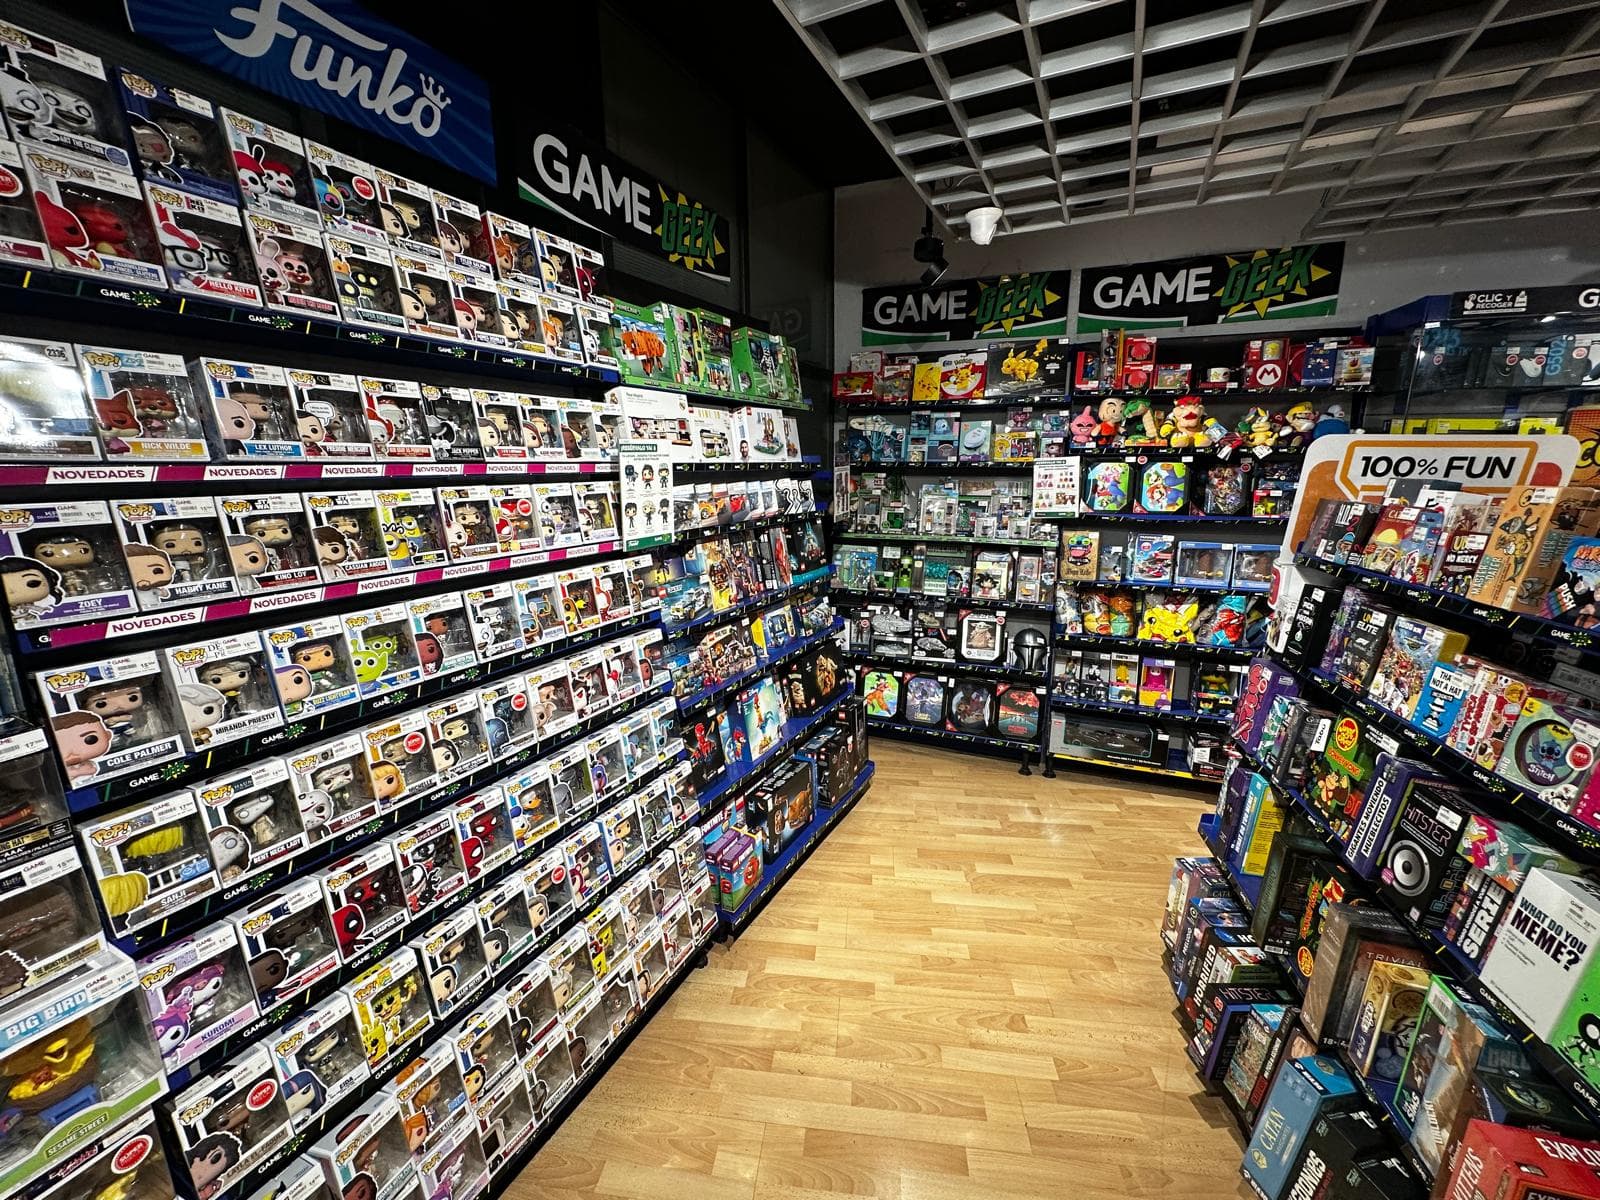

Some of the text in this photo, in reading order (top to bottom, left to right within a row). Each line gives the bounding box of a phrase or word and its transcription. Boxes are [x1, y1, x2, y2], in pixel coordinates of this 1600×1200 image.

[214, 0, 443, 138] Funko
[533, 134, 718, 260] GAME GEEK
[1094, 245, 1318, 309] GAME GEEK
[100, 289, 131, 301] GAME
[209, 279, 256, 296] HELLO KITTY
[874, 272, 1051, 324] GAME GEEK
[1477, 294, 1504, 302] CLIC
[249, 314, 272, 325] GAME
[141, 442, 191, 452] NICK WILDE
[255, 443, 293, 453] LEX LUTHOR
[53, 468, 145, 480] NOVEDADES
[209, 467, 277, 477] NOVEDADES
[325, 466, 378, 475] NOVEDADES
[415, 465, 458, 474] NOVEDADES
[488, 464, 523, 473] NOVEDADES
[1361, 456, 1516, 479] 100% FUN
[512, 553, 545, 565] NOVEDADES
[444, 564, 484, 578] NOVEDADES
[1471, 556, 1489, 596] MASTER
[205, 581, 229, 592] KANE
[361, 576, 410, 591] NOVEDADES
[78, 599, 103, 609] ZOEY
[254, 592, 317, 609] NOVEDADES
[1558, 583, 1577, 610] PUSH
[1473, 608, 1489, 618] GAME
[113, 612, 196, 633] NOVEDADES
[1356, 621, 1379, 635] ELITE
[1551, 629, 1571, 640] GAME
[1432, 678, 1443, 688] NOT
[1449, 685, 1462, 697] HAT
[373, 699, 389, 708] GAME
[215, 713, 277, 736] MIRANDA PRIESTLY
[262, 734, 285, 745] GAME
[107, 743, 172, 767] COLE PALMER
[129, 774, 160, 788] GAME
[1473, 770, 1490, 783] GAME
[431, 792, 447, 801] GAME
[341, 812, 361, 825] JASON
[1348, 778, 1384, 859] GIGANTES MOVIENDO
[1364, 797, 1389, 855] MUEBLECITOS
[1406, 803, 1452, 847] HITSTER
[346, 829, 364, 842] GAME
[1556, 819, 1577, 836] GAME
[161, 891, 187, 906] SANJI
[224, 887, 249, 900] GAME
[443, 897, 459, 909] GAME
[1462, 882, 1505, 958] SERIE
[1519, 897, 1588, 954] WHAT DO YOU
[1510, 908, 1582, 972] MEME?
[351, 956, 371, 969] GAME
[1193, 944, 1216, 1007] HORRIFIED
[1480, 988, 1496, 1006] GAME
[6, 993, 88, 1039] BIG BIRD
[200, 1017, 236, 1043] KUROMI
[243, 1020, 269, 1038] GAME
[375, 1064, 392, 1080] GAME
[339, 1076, 354, 1090] EIDA
[1573, 1082, 1599, 1107] GAME
[1406, 1092, 1420, 1122] SIMS
[47, 1114, 108, 1158] SESAME STREET
[1260, 1107, 1285, 1151] CATAN
[1535, 1137, 1600, 1167] EXPLO
[258, 1152, 284, 1174] GAME
[1453, 1147, 1484, 1200] KITTENS
